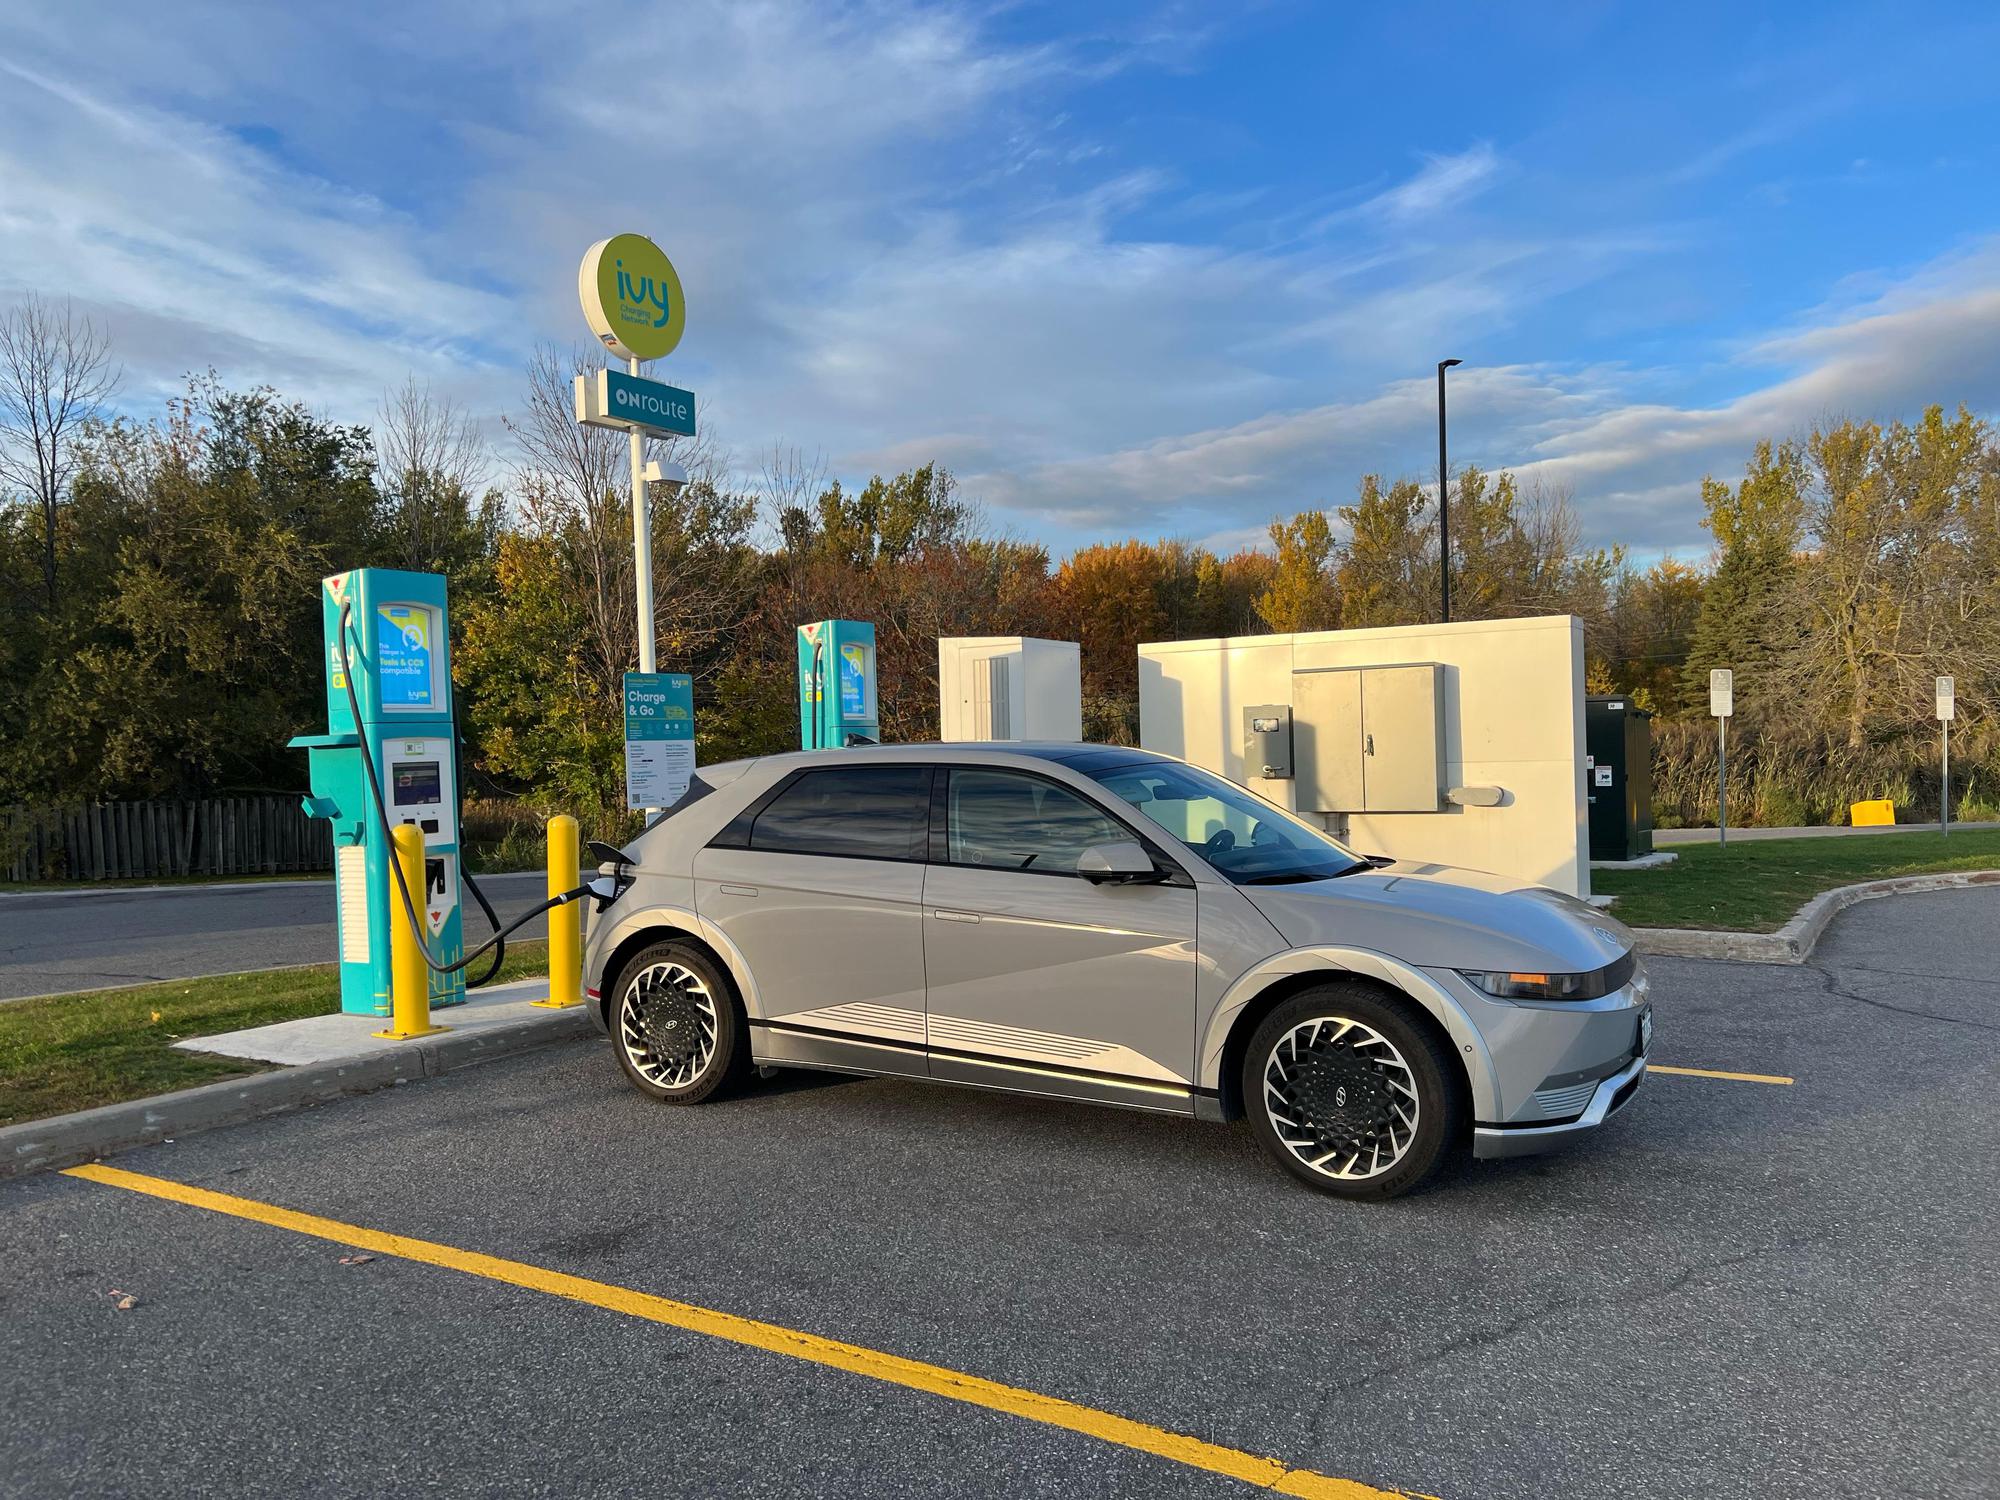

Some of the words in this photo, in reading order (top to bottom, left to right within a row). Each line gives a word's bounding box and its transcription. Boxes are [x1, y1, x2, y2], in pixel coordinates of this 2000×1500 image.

[616, 259, 670, 328] ivy
[621, 304, 651, 319] Charging
[621, 313, 649, 327] Network
[380, 667, 421, 676] compatible
[628, 690, 666, 705] Charge
[629, 705, 638, 716] &
[640, 705, 655, 716] Go
